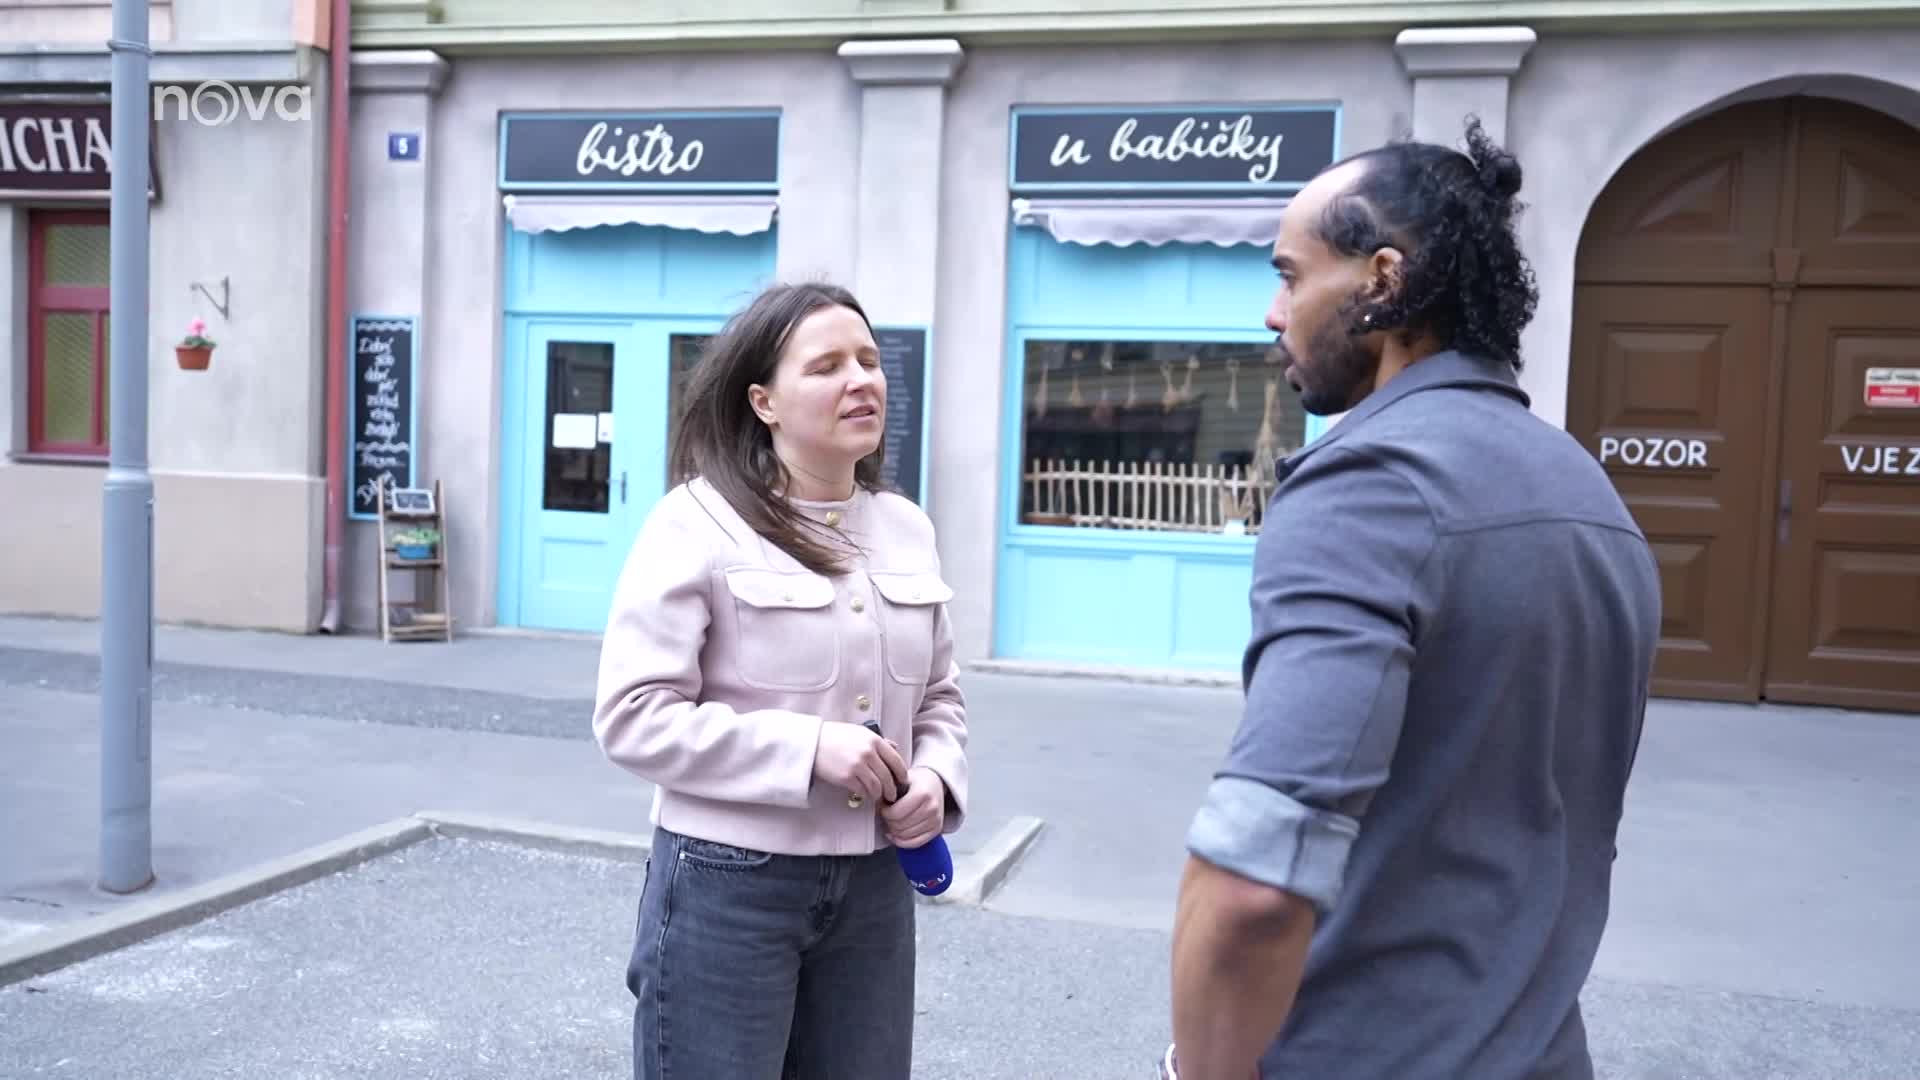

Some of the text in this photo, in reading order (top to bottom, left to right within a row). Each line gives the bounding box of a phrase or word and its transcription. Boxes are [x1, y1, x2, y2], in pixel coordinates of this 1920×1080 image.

[576, 121, 704, 176] bistro
[1050, 115, 1283, 183] u babičky
[1600, 437, 1708, 467] POZOR
